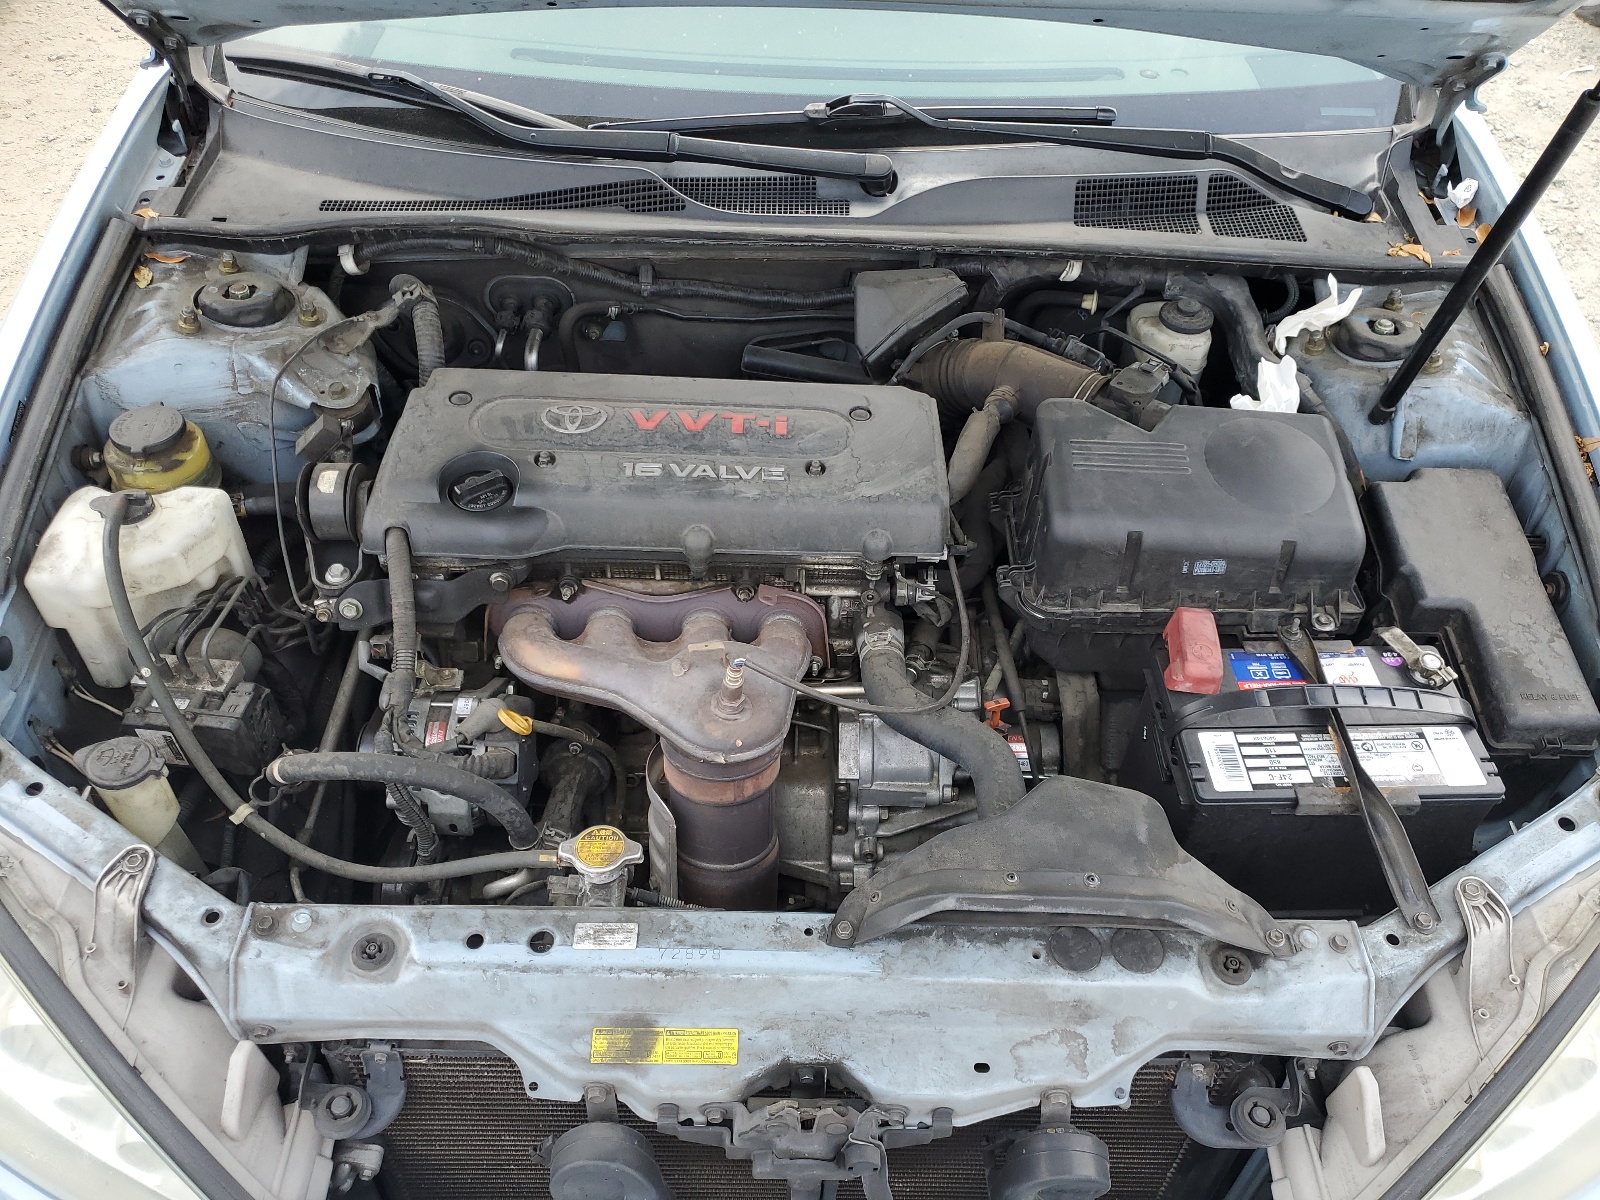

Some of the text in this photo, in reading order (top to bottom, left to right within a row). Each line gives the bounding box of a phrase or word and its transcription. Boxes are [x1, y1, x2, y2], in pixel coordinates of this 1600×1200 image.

[629, 410, 788, 436] VVT-i
[623, 462, 786, 481] 16 VALVE
[1268, 773, 1293, 781] 24F-C
